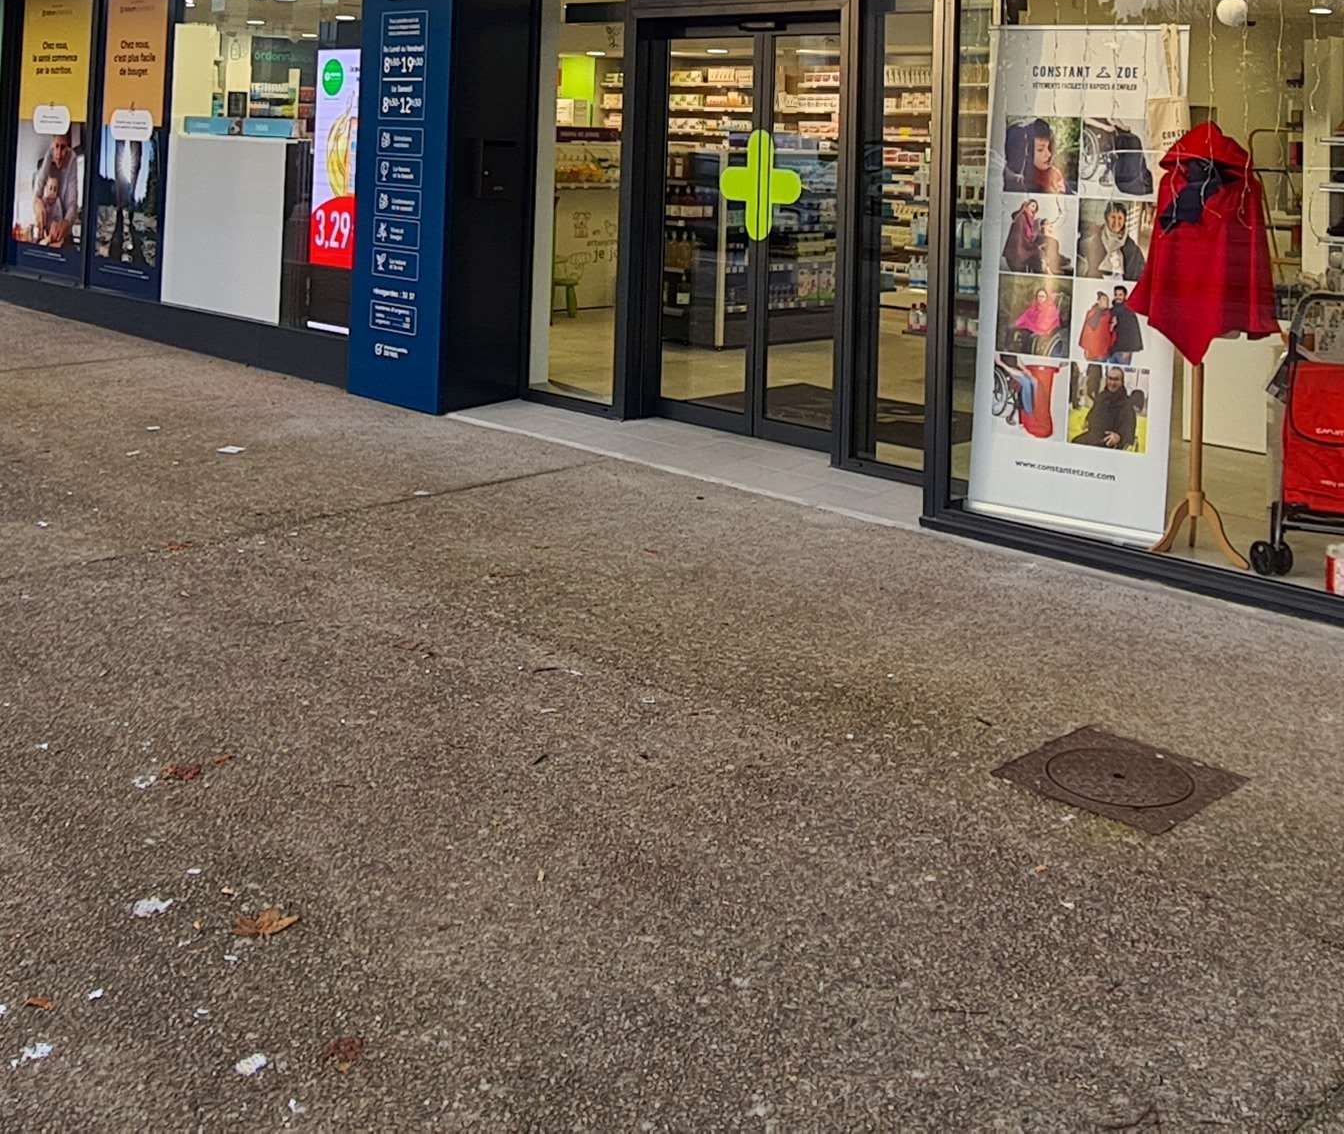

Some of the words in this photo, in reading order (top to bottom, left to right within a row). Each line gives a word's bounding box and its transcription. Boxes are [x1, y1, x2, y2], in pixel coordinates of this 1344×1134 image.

[1032, 65, 1091, 78] CONSTANT
[1116, 66, 1139, 79] ZOE
[1015, 459, 1116, 482] www.constantetzoe.com
